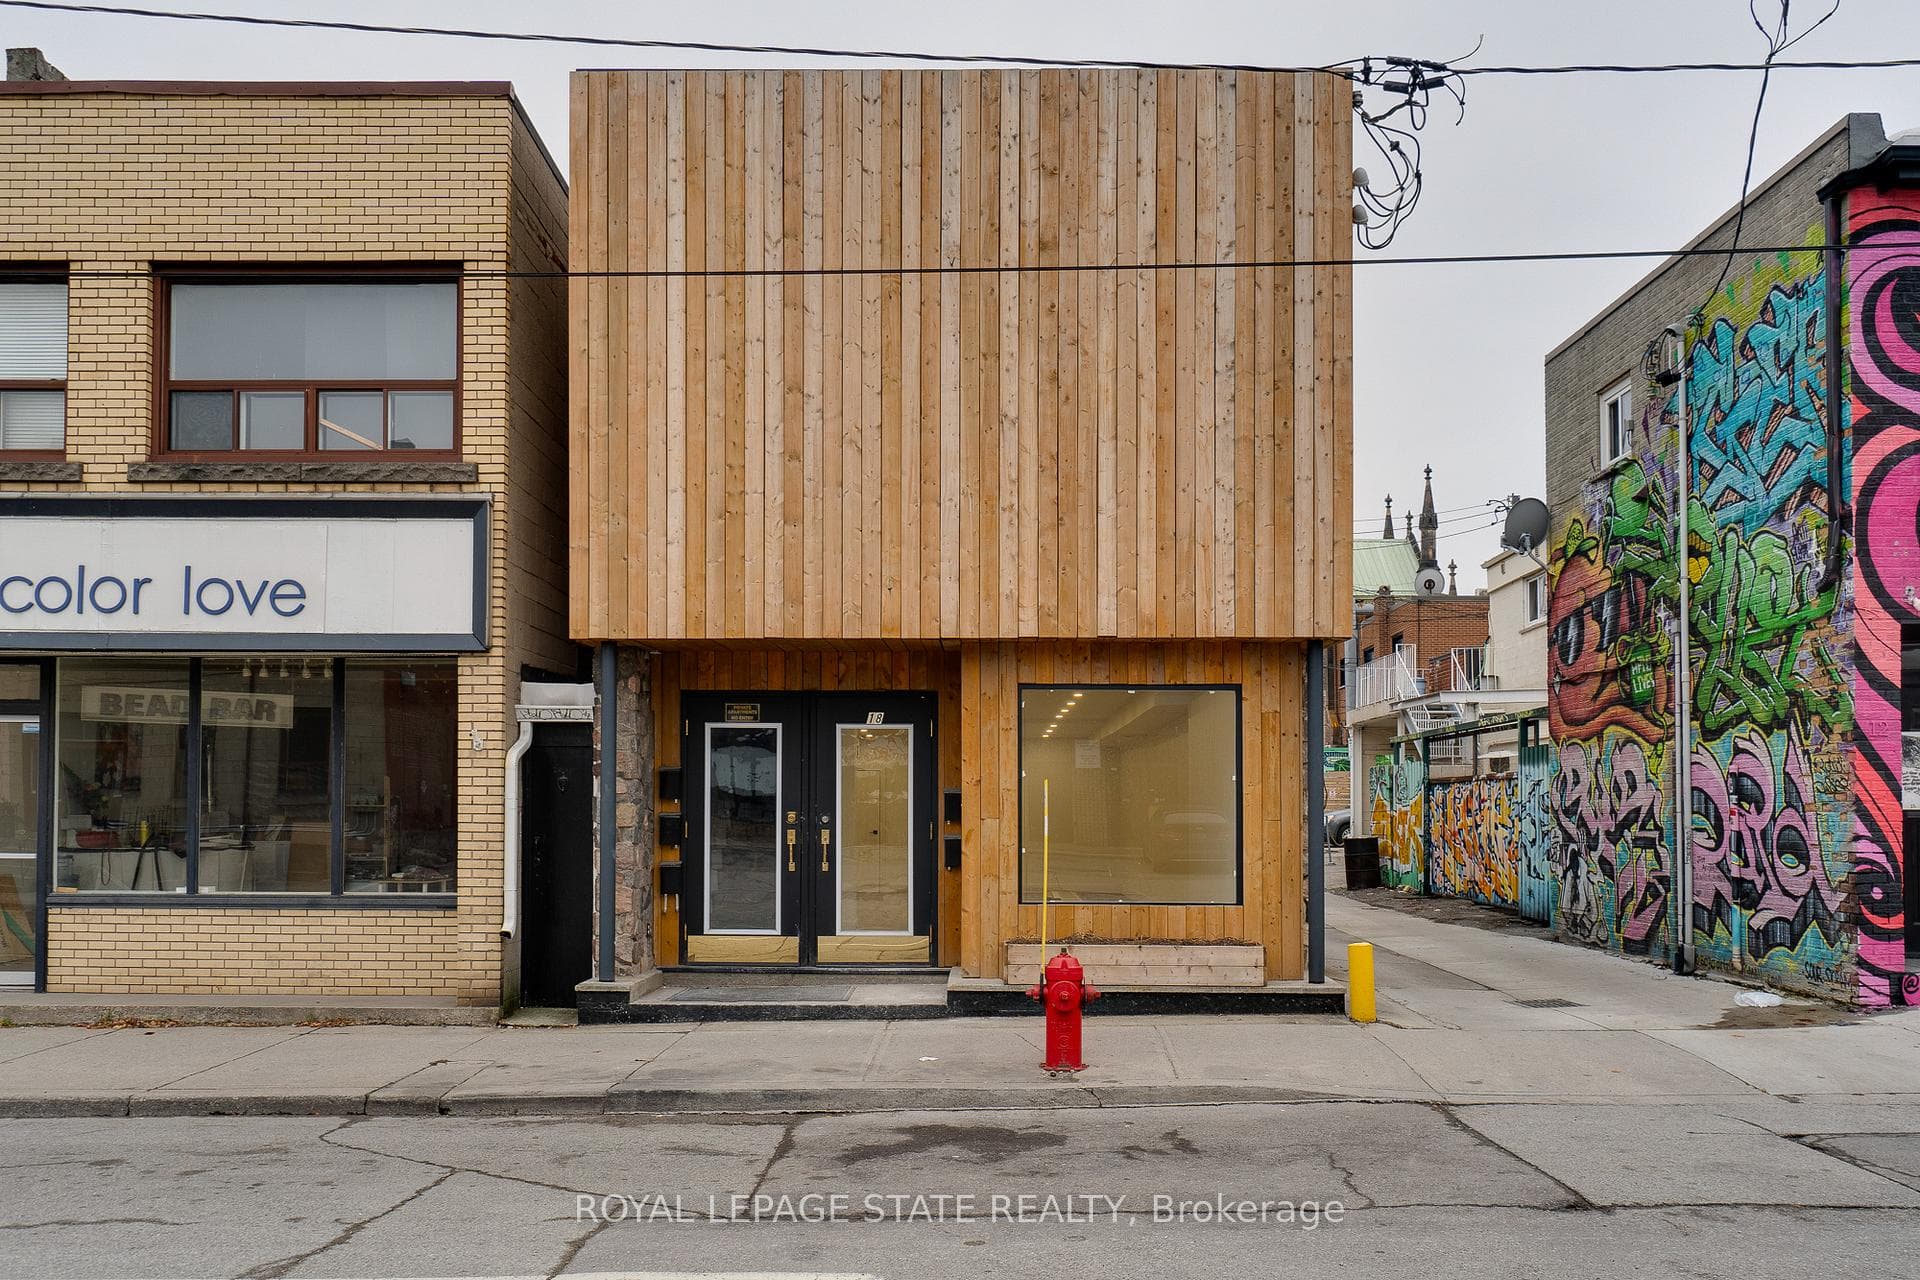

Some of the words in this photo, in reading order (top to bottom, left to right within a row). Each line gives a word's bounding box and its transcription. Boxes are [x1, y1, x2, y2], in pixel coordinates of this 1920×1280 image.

[0, 565, 153, 615] color
[183, 565, 307, 617] love
[100, 692, 190, 718] BEAD
[208, 697, 277, 723] BAR
[868, 712, 883, 724] 18
[1868, 721, 1889, 738] 12
